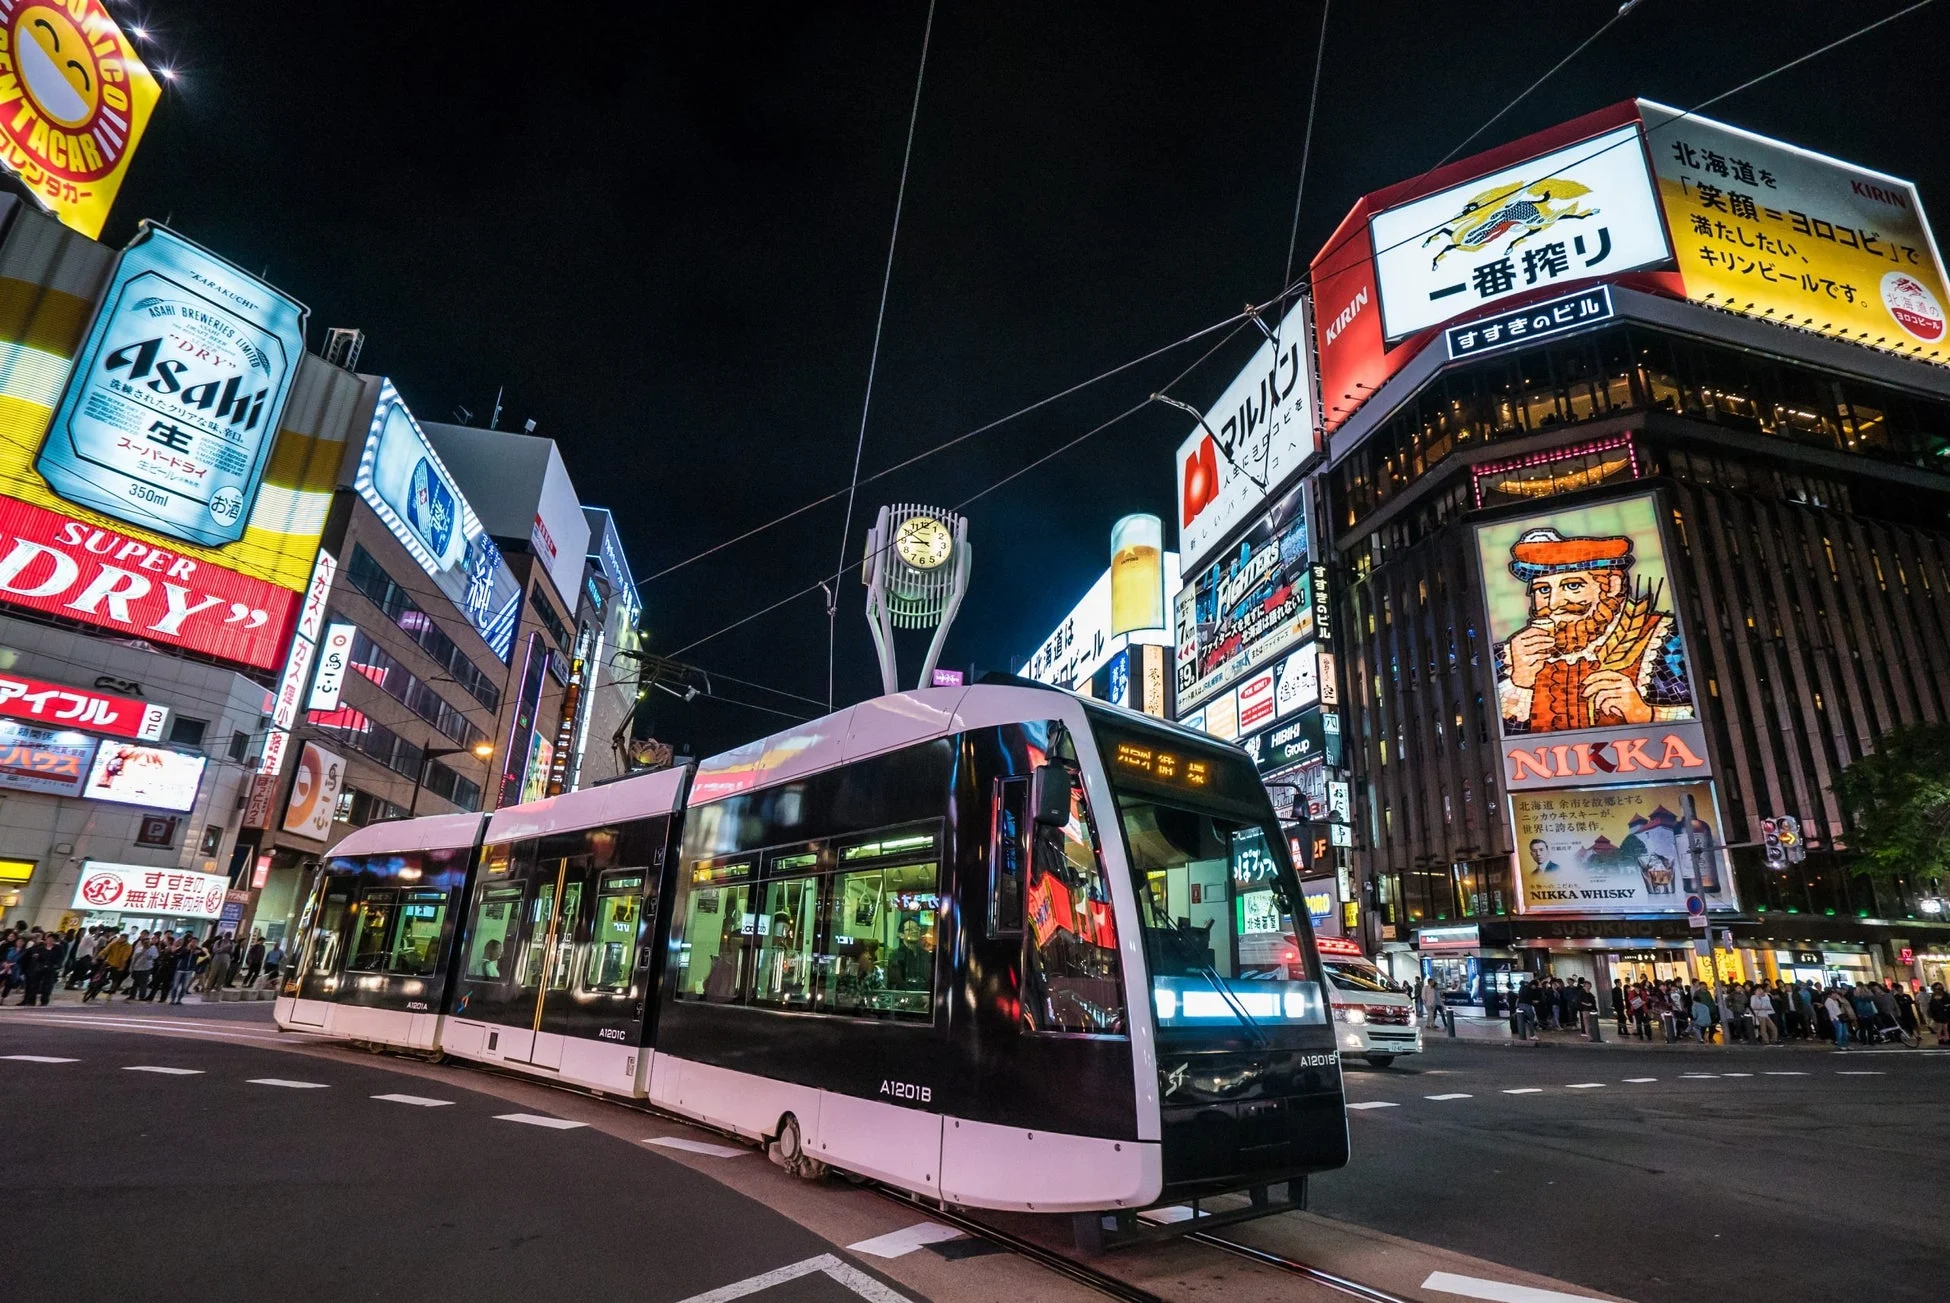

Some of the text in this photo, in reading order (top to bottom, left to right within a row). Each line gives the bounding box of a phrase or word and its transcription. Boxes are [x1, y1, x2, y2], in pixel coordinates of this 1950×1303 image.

[1671, 140, 1777, 190] 北海道を
[1850, 180, 1907, 209] KIRIN
[1690, 212, 1809, 264] 満たしたい、
[1428, 226, 1612, 302] 一番搾り
[1699, 245, 1868, 309] キリンビールです。
[1325, 286, 1368, 347] KIRIN
[1457, 298, 1601, 350] すすきのビル
[148, 305, 176, 319] ASAHI
[181, 306, 236, 339] BREWERIES
[235, 338, 261, 368] LIMITED
[103, 336, 268, 432] Asahi
[1220, 342, 1298, 453] マルハン
[146, 420, 193, 455] 生
[117, 437, 208, 478] スーパードライ
[128, 483, 169, 507] 350ml
[210, 495, 242, 520] お酒
[911, 522, 919, 531] 11
[938, 532, 945, 541] 2
[54, 522, 198, 582] SUPER
[903, 546, 909, 554] 8
[911, 553, 917, 561] 7
[936, 550, 942, 558] 4
[940, 541, 947, 550] 3
[919, 557, 926, 565] 6
[929, 555, 936, 564] 5
[1213, 540, 1279, 634] FIGHTERS
[1313, 565, 1331, 640] すすきのビル
[1034, 617, 1074, 679] 北海道は
[0, 680, 119, 726] アイフル
[145, 710, 163, 735] 3F
[1271, 722, 1300, 749] HIBIKI
[1284, 739, 1310, 758] Group
[1507, 734, 1705, 781] NIKKA
[1519, 801, 1554, 812] 北海道
[1522, 822, 1604, 834] 世界に誇る傑作。
[144, 872, 204, 893] すすきの
[1530, 888, 1636, 900] NIKKA WHISKY
[123, 889, 204, 913] 無料案内所
[1551, 921, 1654, 936] SUSUKINO
[406, 1001, 428, 1010] A1201A
[599, 1028, 626, 1041] A1201C
[1300, 1055, 1336, 1068] A1201B
[880, 1079, 932, 1103] A1201B
